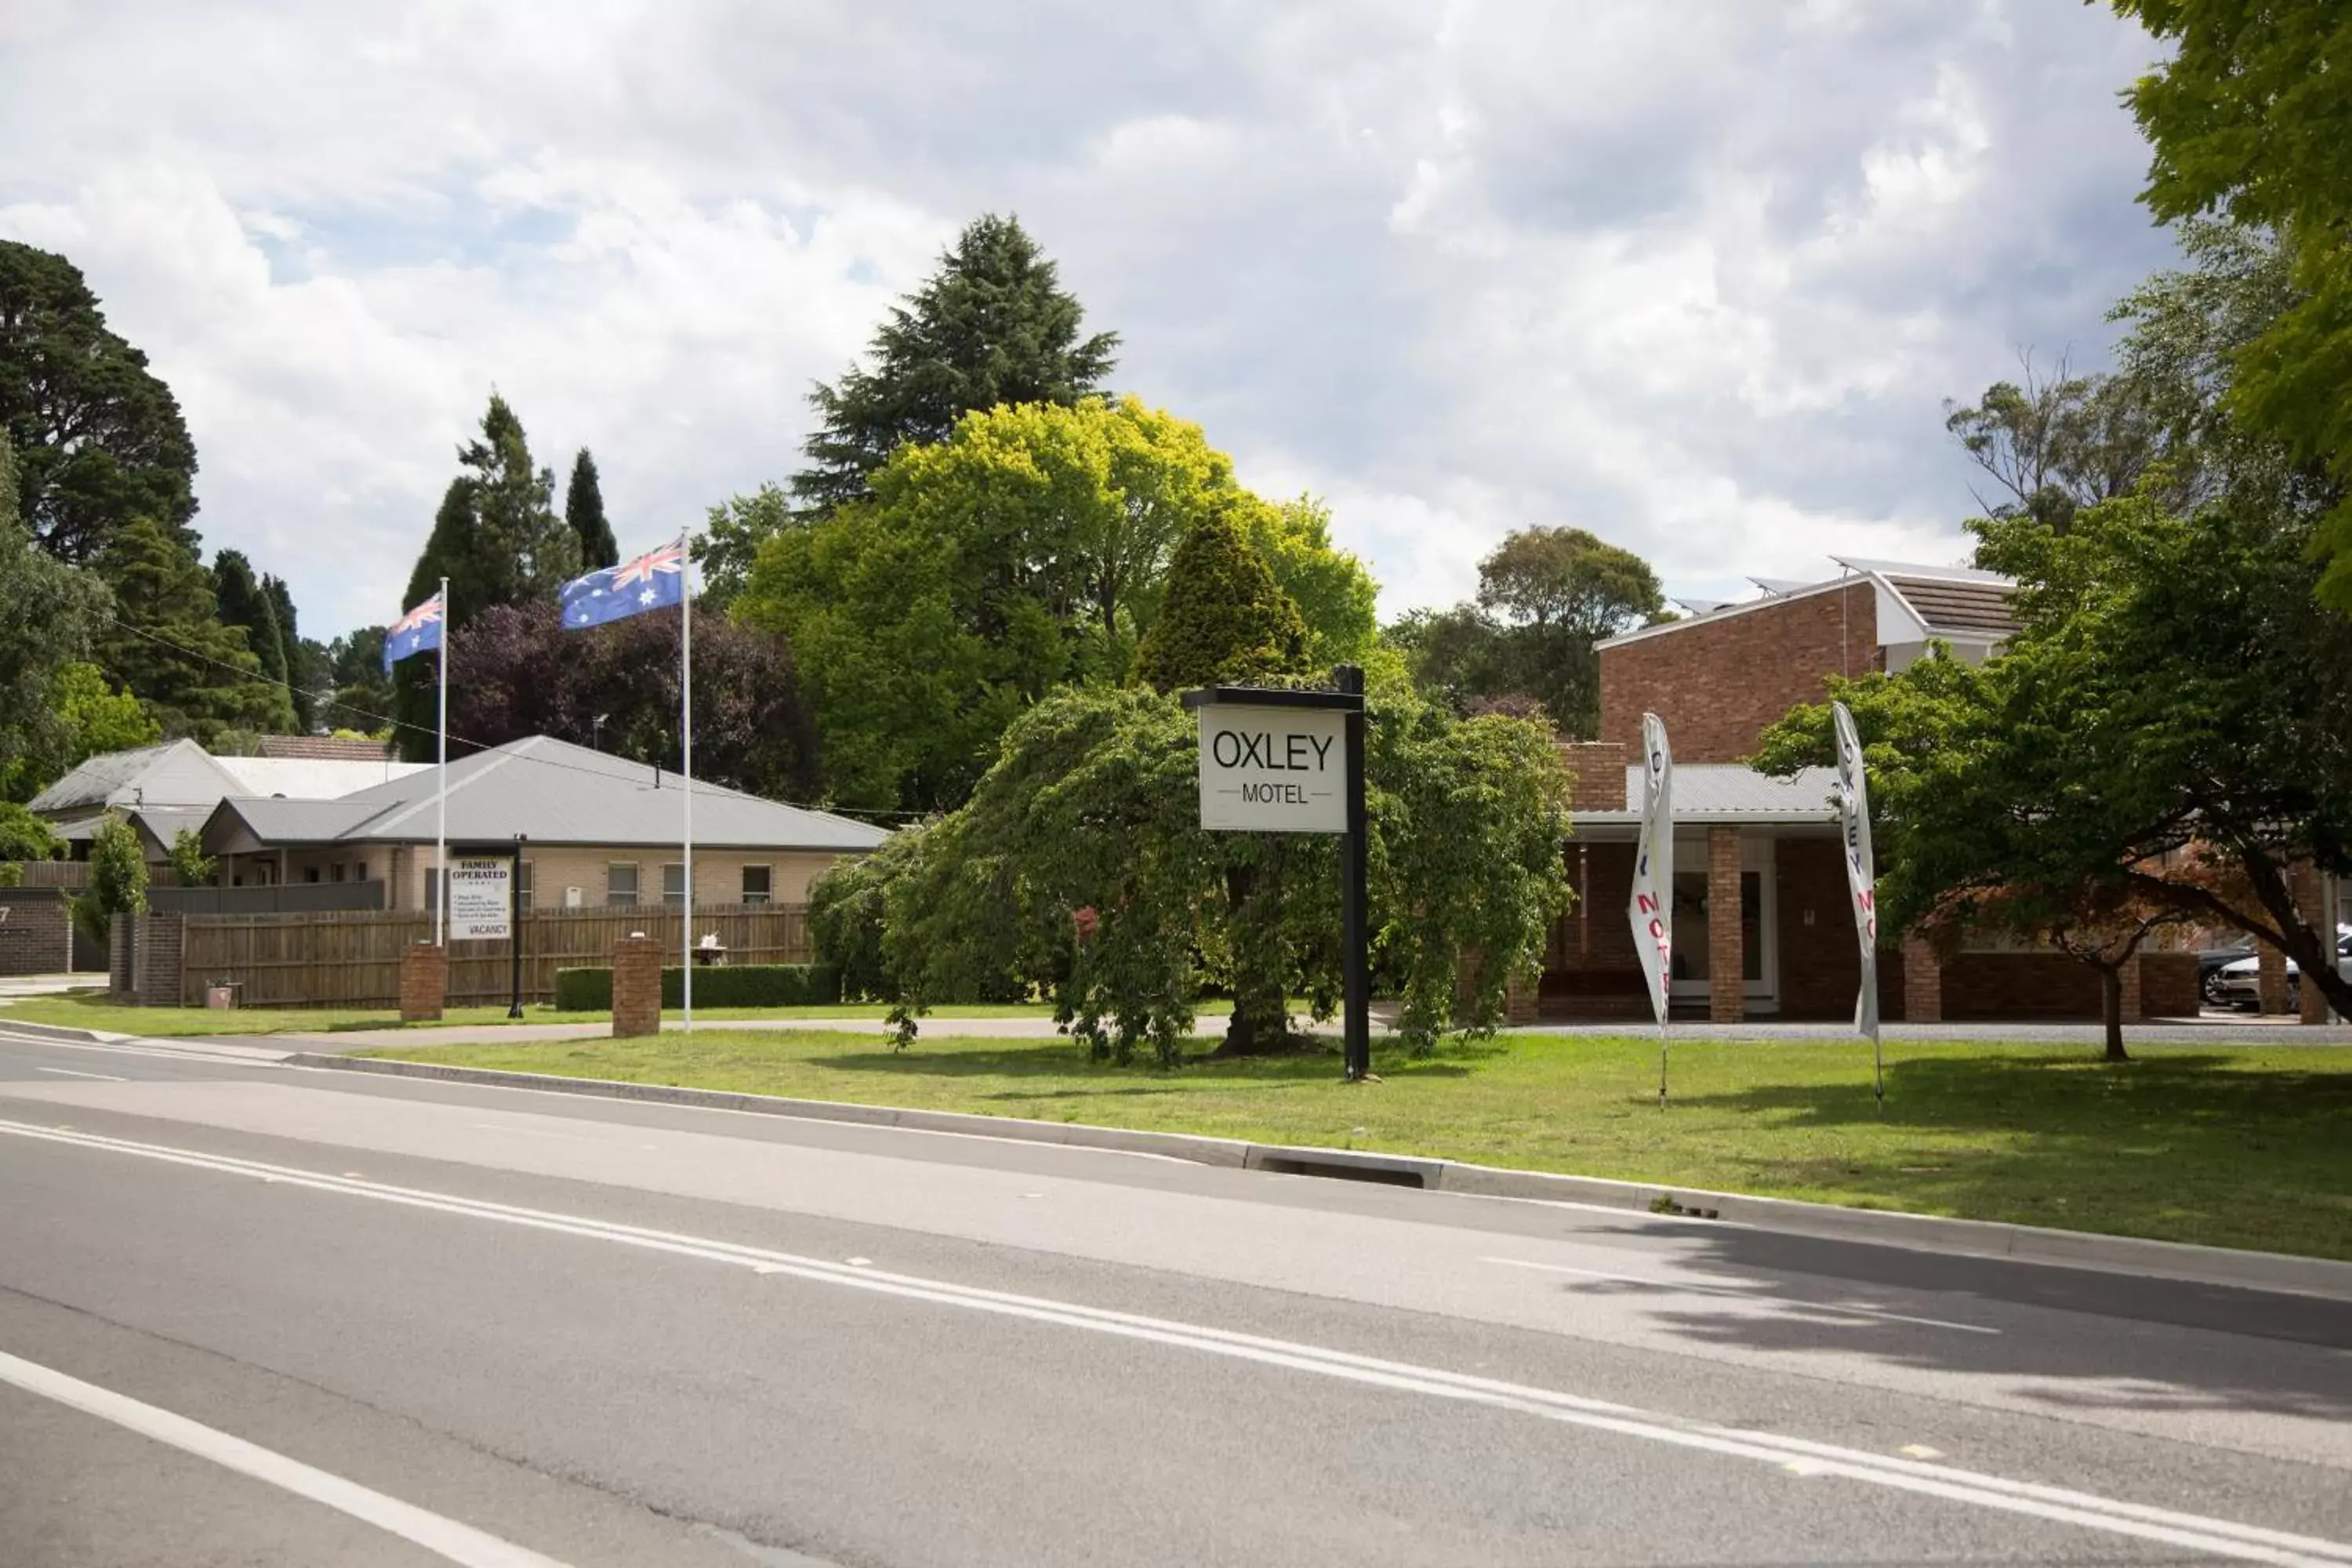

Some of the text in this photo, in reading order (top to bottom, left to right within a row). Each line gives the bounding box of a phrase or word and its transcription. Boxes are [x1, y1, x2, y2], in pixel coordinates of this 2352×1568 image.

[1213, 730, 1333, 772] OXLEY
[1242, 782, 1310, 804] MOTEL
[460, 860, 497, 869] FAMILY
[452, 870, 508, 880] OPERATED
[469, 925, 508, 935] VACANCY
